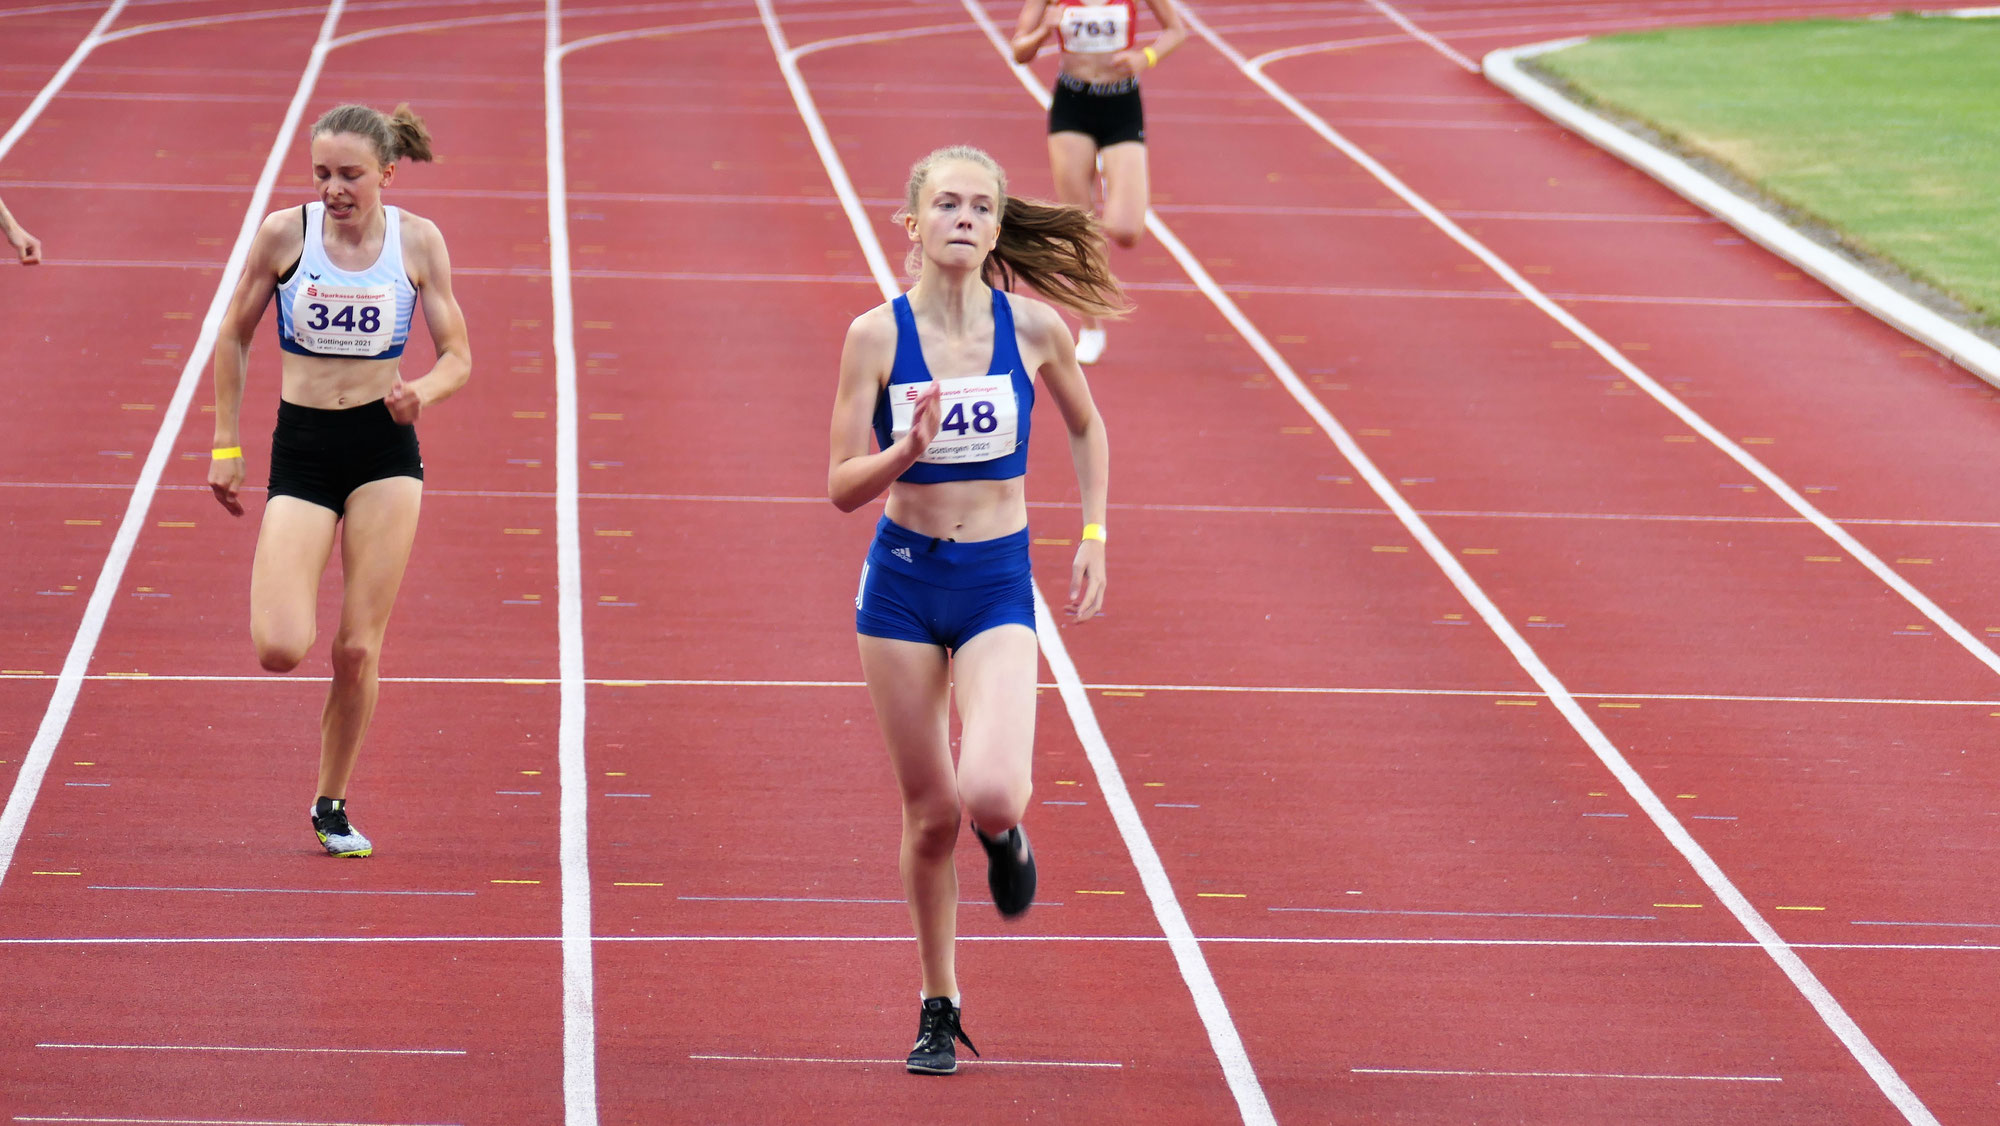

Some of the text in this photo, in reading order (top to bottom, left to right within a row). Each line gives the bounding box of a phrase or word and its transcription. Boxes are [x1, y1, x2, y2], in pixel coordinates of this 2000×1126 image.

[1071, 21, 1115, 37] 763
[1088, 79, 1130, 96] NIKE
[307, 303, 381, 333] 348
[317, 337, 371, 347] Göttingen 2021
[941, 400, 998, 436] 48
[928, 442, 990, 455] Göttingen 2021
